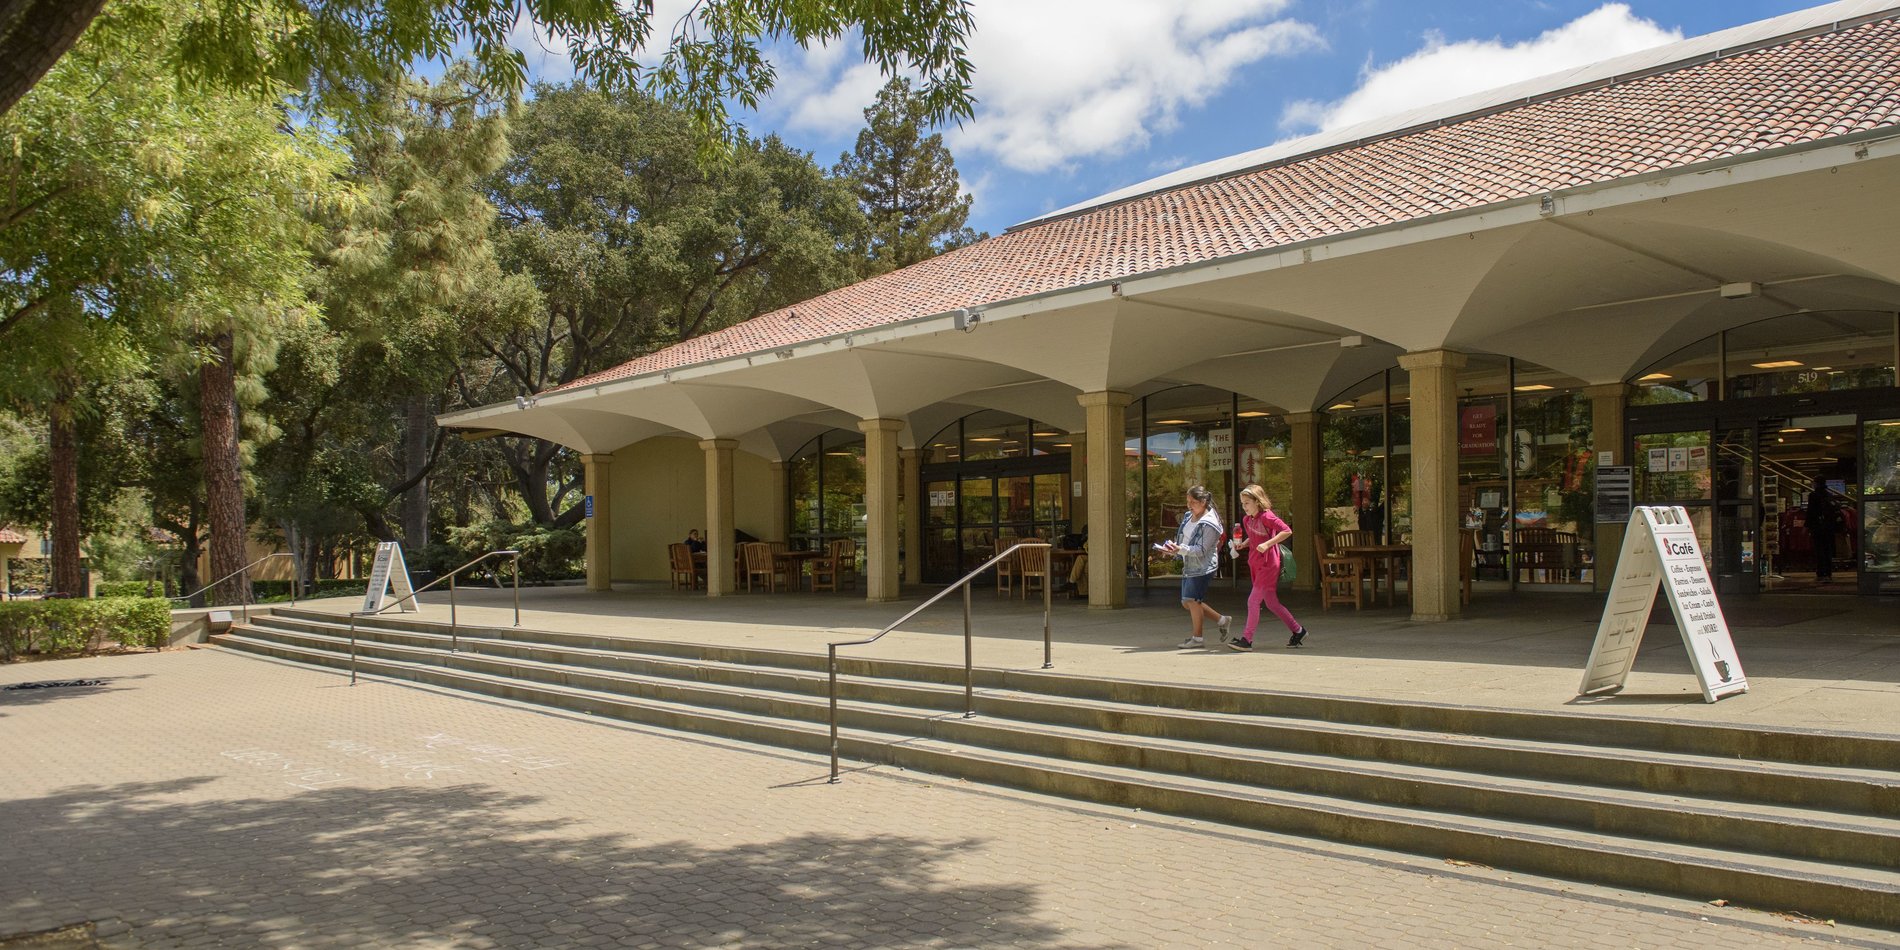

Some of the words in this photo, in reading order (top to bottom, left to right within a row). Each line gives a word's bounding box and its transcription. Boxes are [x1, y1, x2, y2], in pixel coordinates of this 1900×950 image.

[1798, 371, 1818, 383] 519
[1214, 434, 1229, 442] THE
[1212, 446, 1232, 454] NEXT
[1212, 458, 1231, 467] STEP
[1671, 542, 1694, 556] Café
[1671, 564, 1684, 574] Coffee
[1685, 564, 1701, 575] Espresso
[1674, 577, 1689, 586] Pastries
[1690, 576, 1707, 585] Desserts
[1677, 588, 1698, 598] Sandwiches
[1699, 586, 1712, 596] Salads
[1689, 601, 1701, 610] Cream
[1703, 599, 1715, 609] Candy
[1689, 612, 1704, 622] Bottled
[1703, 611, 1716, 620] Drinks
